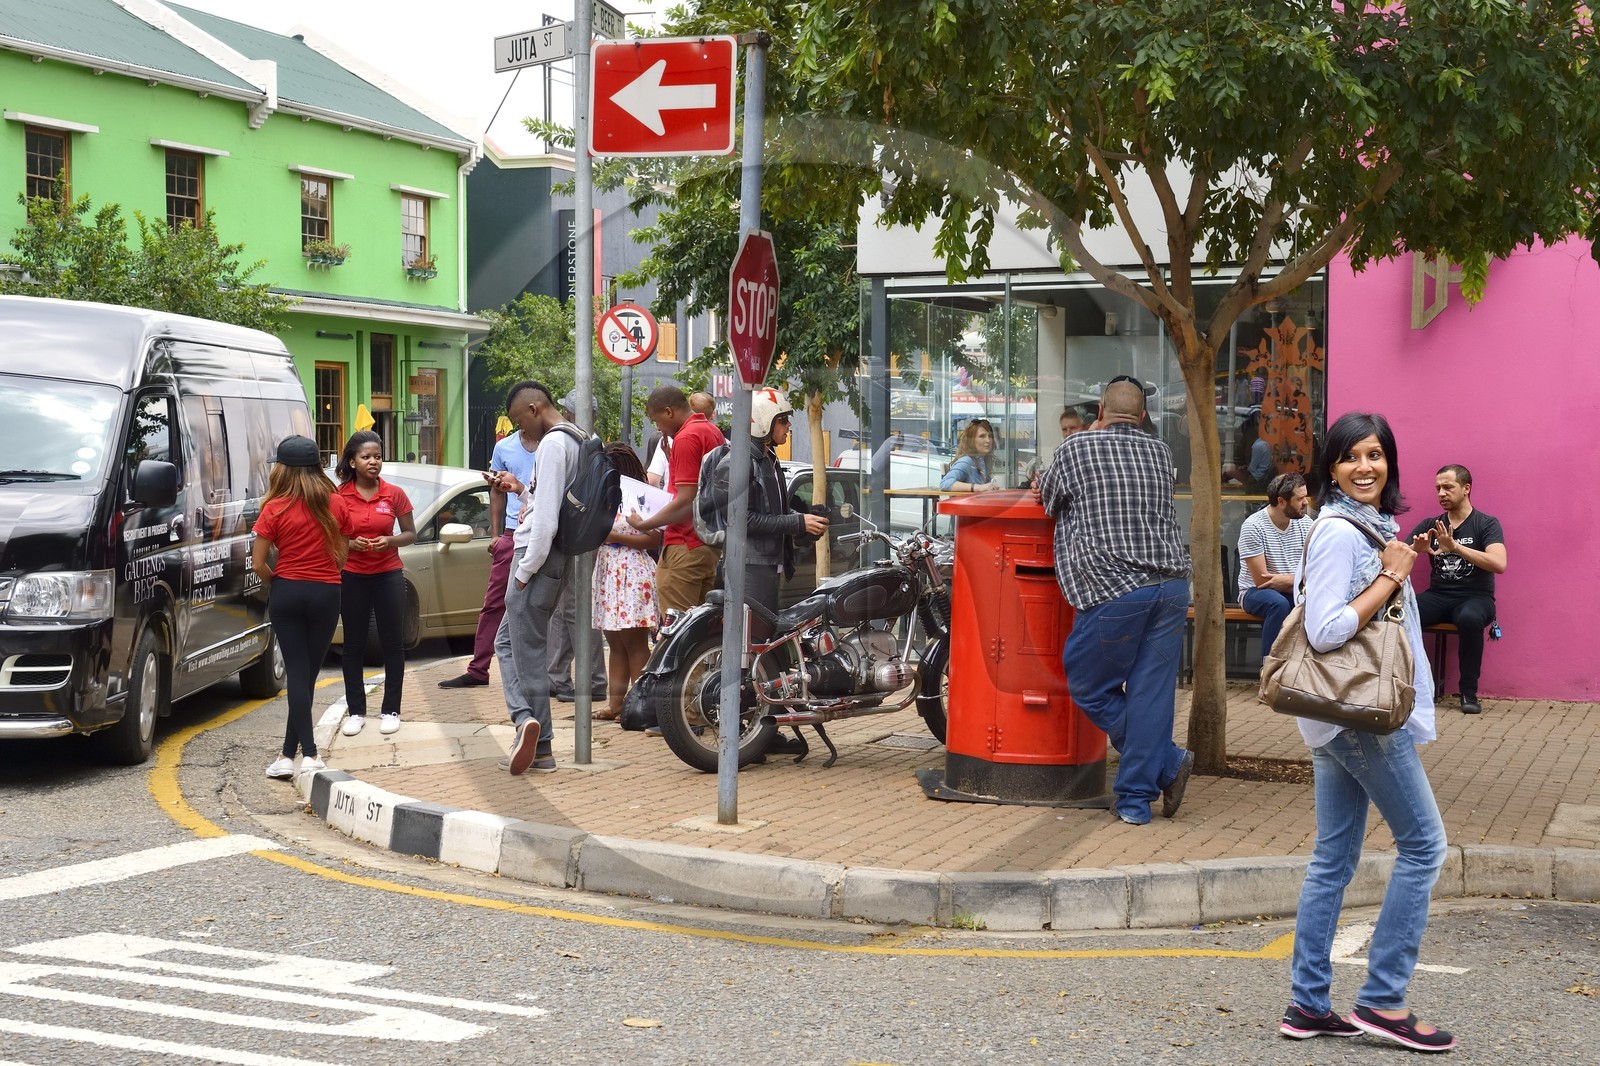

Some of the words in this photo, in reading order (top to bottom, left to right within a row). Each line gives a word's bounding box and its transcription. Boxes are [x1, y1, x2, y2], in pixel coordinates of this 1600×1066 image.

[600, 8, 615, 38] BEER
[507, 36, 537, 64] JUTA
[543, 32, 553, 47] ST
[734, 277, 777, 340] STOP
[1434, 537, 1474, 545] RNES
[193, 563, 224, 584] REPRESENTATIVE
[133, 576, 158, 604] BEST
[334, 789, 355, 816] JUTA
[366, 801, 383, 822] ST
